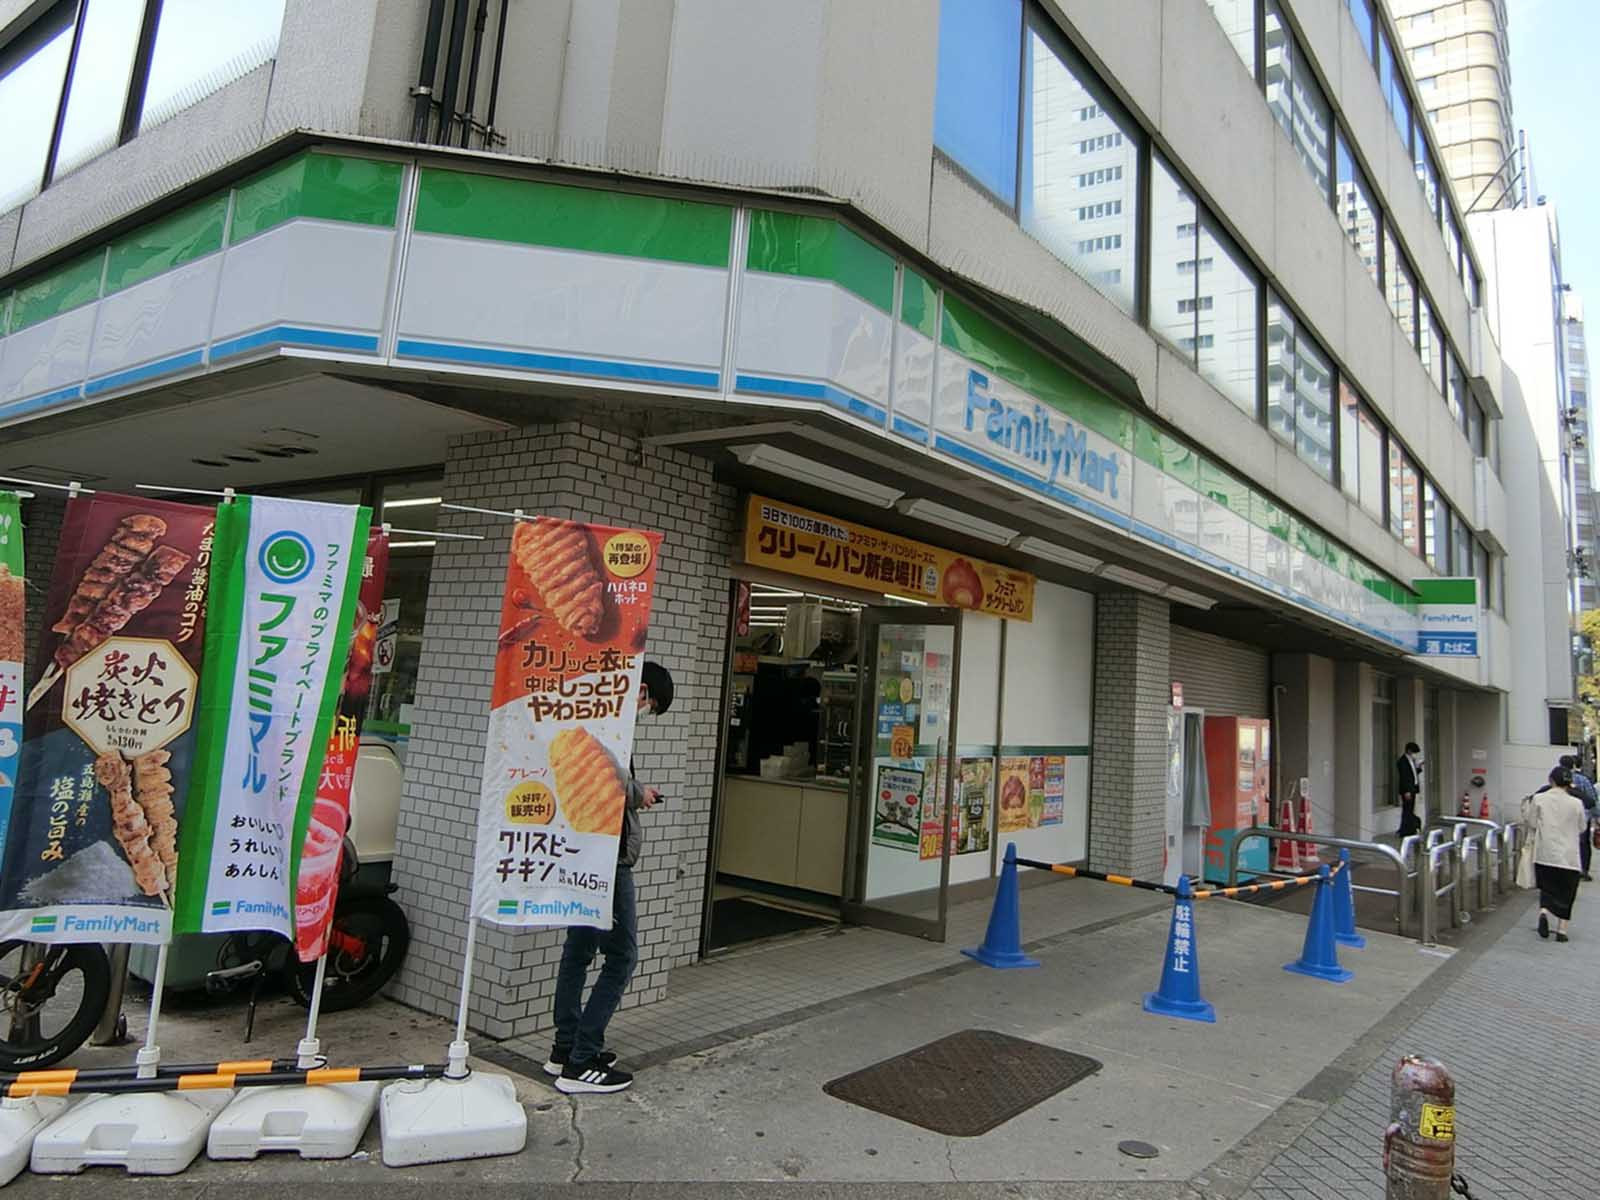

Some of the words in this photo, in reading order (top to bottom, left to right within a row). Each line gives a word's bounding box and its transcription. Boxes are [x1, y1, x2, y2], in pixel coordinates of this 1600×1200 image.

[964, 368, 1120, 500] FamilyMart
[607, 580, 648, 593] ハバネロ
[97, 649, 167, 687] 炭火
[522, 640, 636, 673] カリッと衣に
[278, 543, 340, 802] ファミマのプライベートブランド
[525, 674, 630, 697] 中はしっとり
[72, 682, 188, 726] 焼きとり
[241, 592, 298, 794] ファミマル
[527, 695, 625, 722] やわらか!
[507, 767, 549, 779] プレーン
[41, 776, 75, 861] 塩の旨み
[499, 831, 581, 858] クリスピー
[225, 863, 279, 881] あんしん
[496, 857, 556, 884] チキン
[523, 900, 600, 919] FamilyMart
[63, 914, 161, 934] FamilyMart
